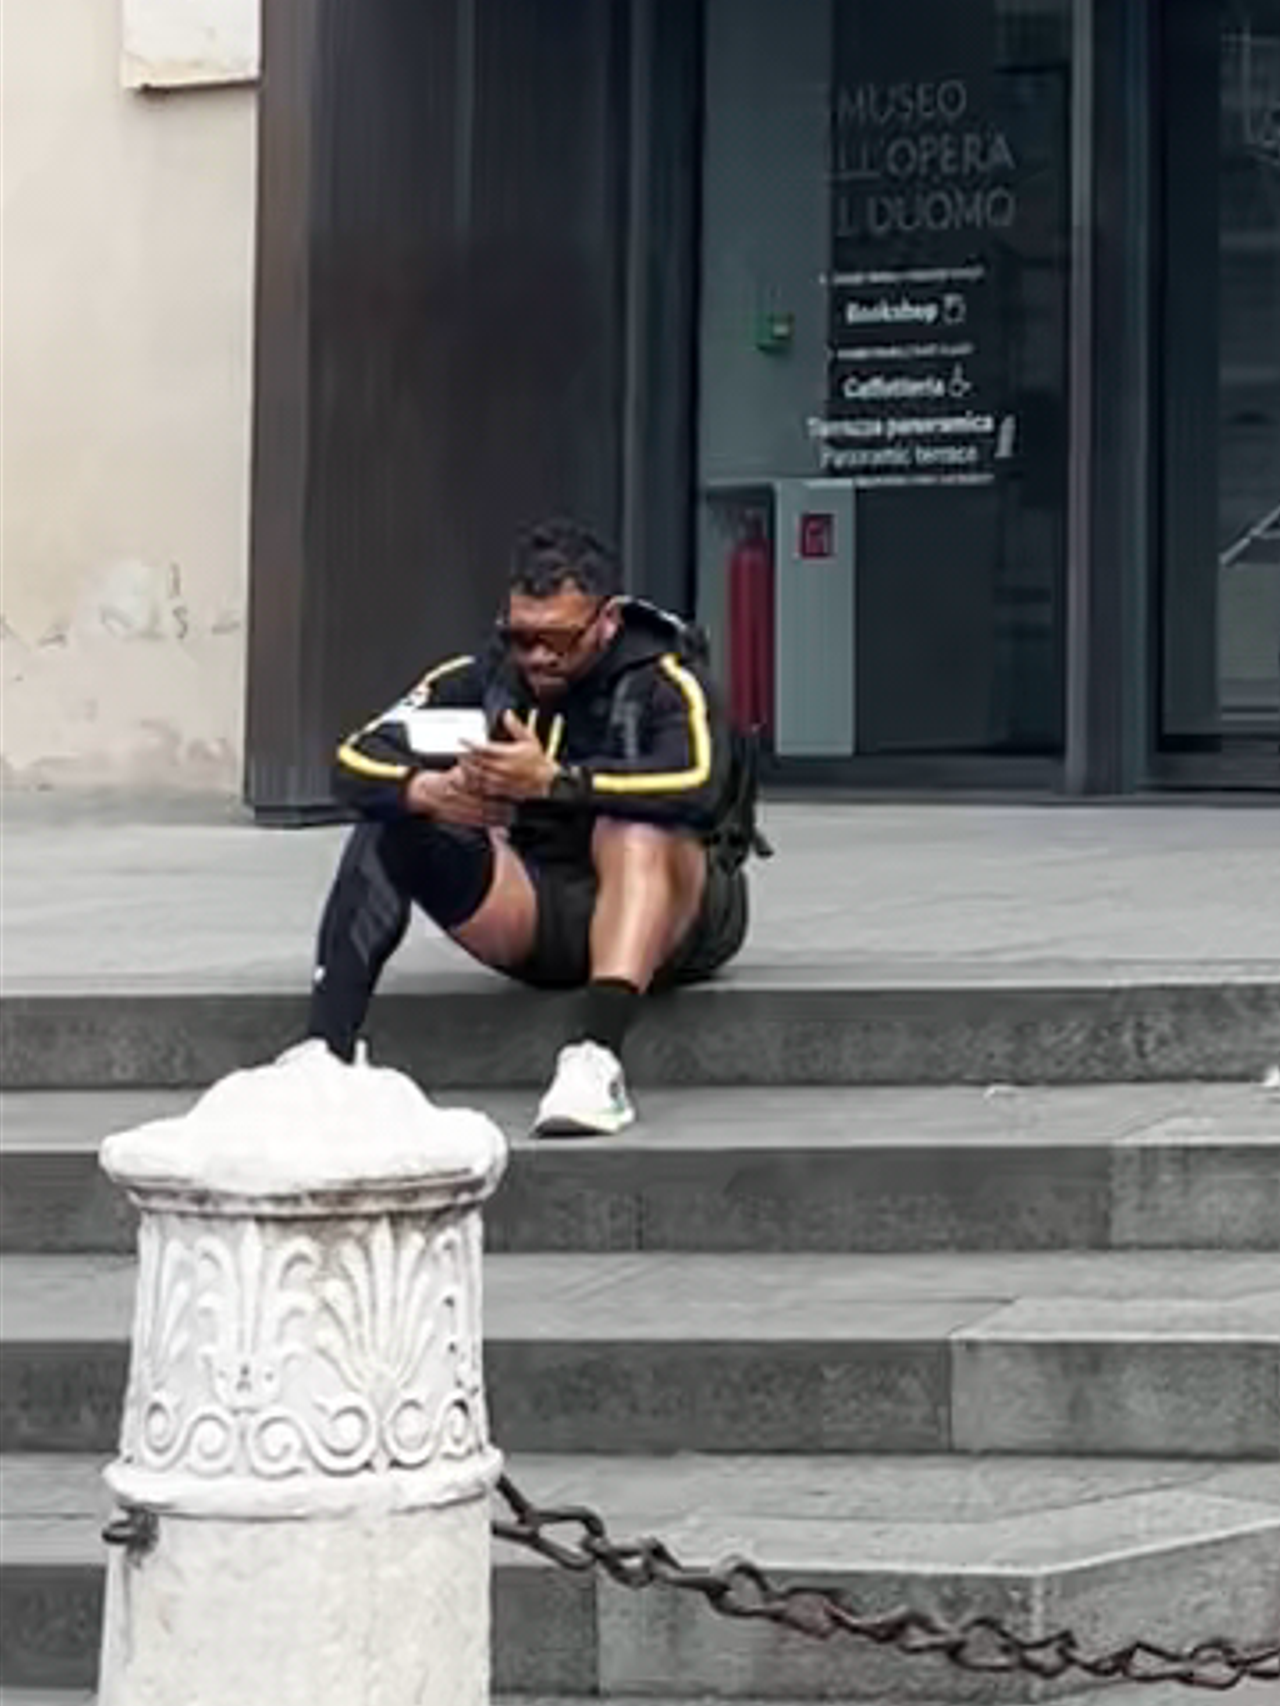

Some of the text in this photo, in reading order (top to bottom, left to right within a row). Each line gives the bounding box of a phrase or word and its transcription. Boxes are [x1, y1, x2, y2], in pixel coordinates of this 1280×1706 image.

[837, 79, 968, 126] MUSEO
[866, 185, 1016, 237] DUOMO
[846, 296, 939, 325] Bookshop
